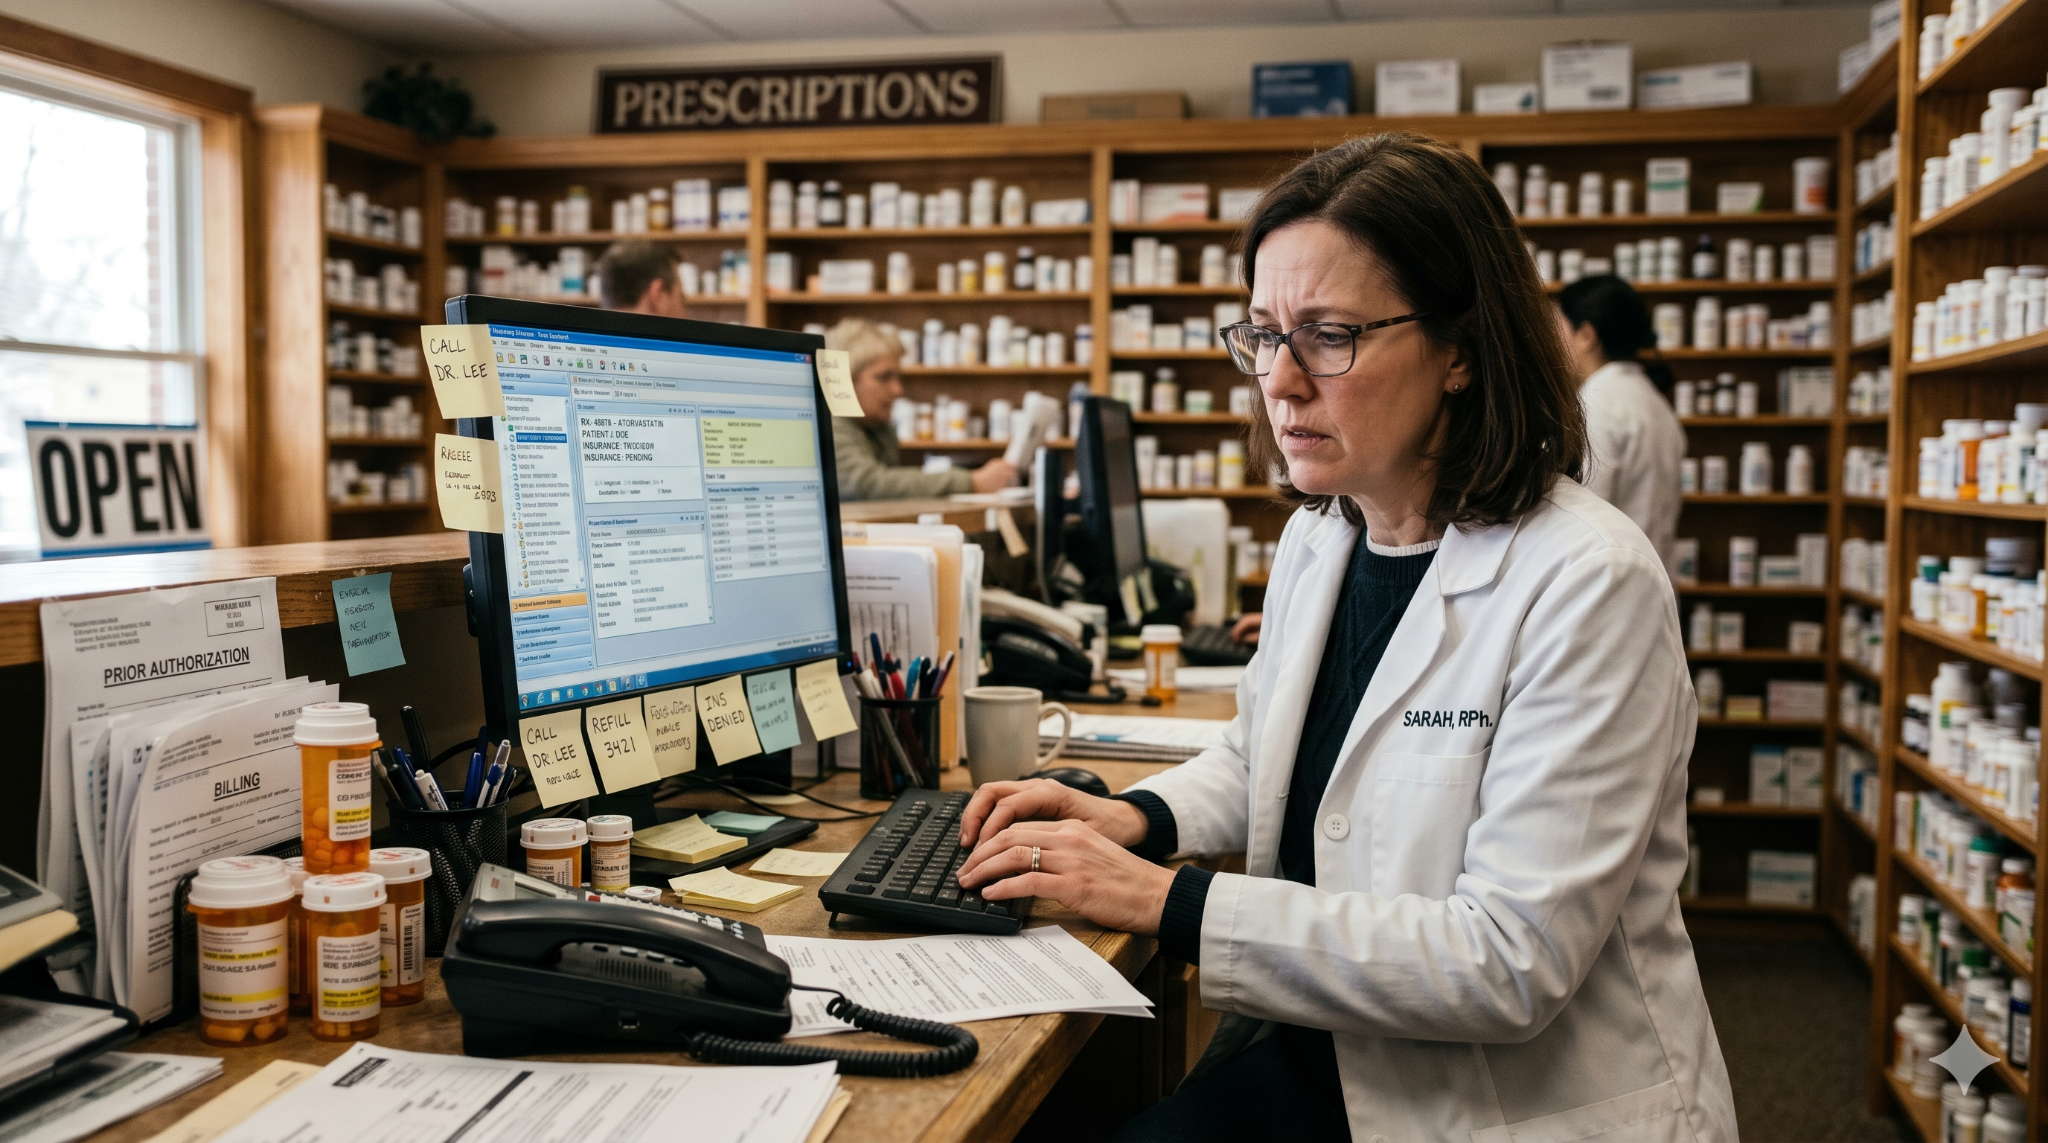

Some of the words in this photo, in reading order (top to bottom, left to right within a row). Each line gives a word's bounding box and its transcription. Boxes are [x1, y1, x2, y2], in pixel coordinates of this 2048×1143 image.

[612, 69, 980, 128] PRESCRIPTIONS
[430, 338, 466, 354] CALL
[434, 364, 460, 381] DR.
[463, 362, 488, 378] LEE
[618, 419, 664, 428] ATORVASTATIN
[582, 430, 608, 439] PATIENT
[610, 430, 615, 439] J.
[616, 430, 629, 439] DOE
[583, 442, 622, 450] INSURANCE:
[39, 438, 202, 538] OPEN
[104, 663, 147, 685] PRIOR
[150, 646, 250, 677] AUTHORIZATION
[704, 692, 728, 712] INS
[592, 712, 631, 734] REFILL
[707, 709, 745, 733] DENIED
[1403, 710, 1455, 730] SARAH,
[1458, 709, 1493, 728] RPh.
[526, 726, 558, 745] CALL
[555, 744, 577, 762] LEE
[604, 736, 636, 759] 3421
[214, 772, 261, 798] BILLING
